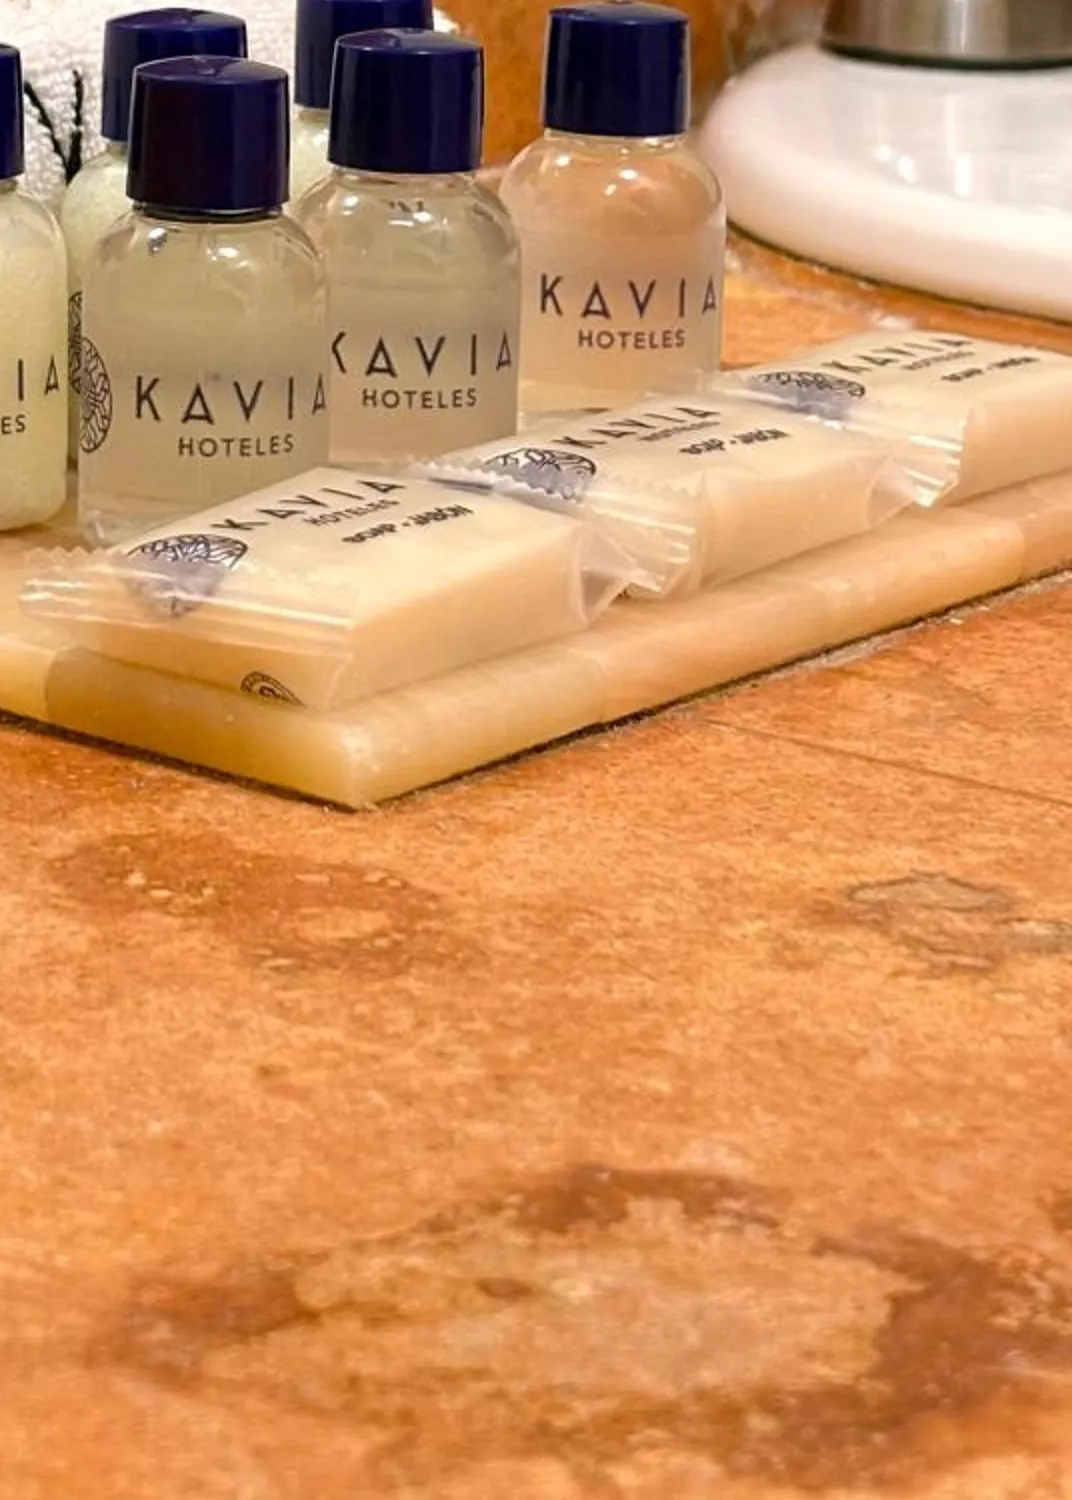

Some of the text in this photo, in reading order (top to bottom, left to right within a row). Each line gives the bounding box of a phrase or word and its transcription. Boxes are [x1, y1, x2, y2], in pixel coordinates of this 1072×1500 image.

[539, 273, 717, 320] KAVIA
[578, 329, 686, 351] HOTELES
[134, 373, 327, 426] KAVIA
[362, 387, 477, 410] HOTELES
[178, 433, 294, 458] HOTELES
[550, 406, 721, 449] KAVIA
[210, 480, 407, 531] KAVIA
